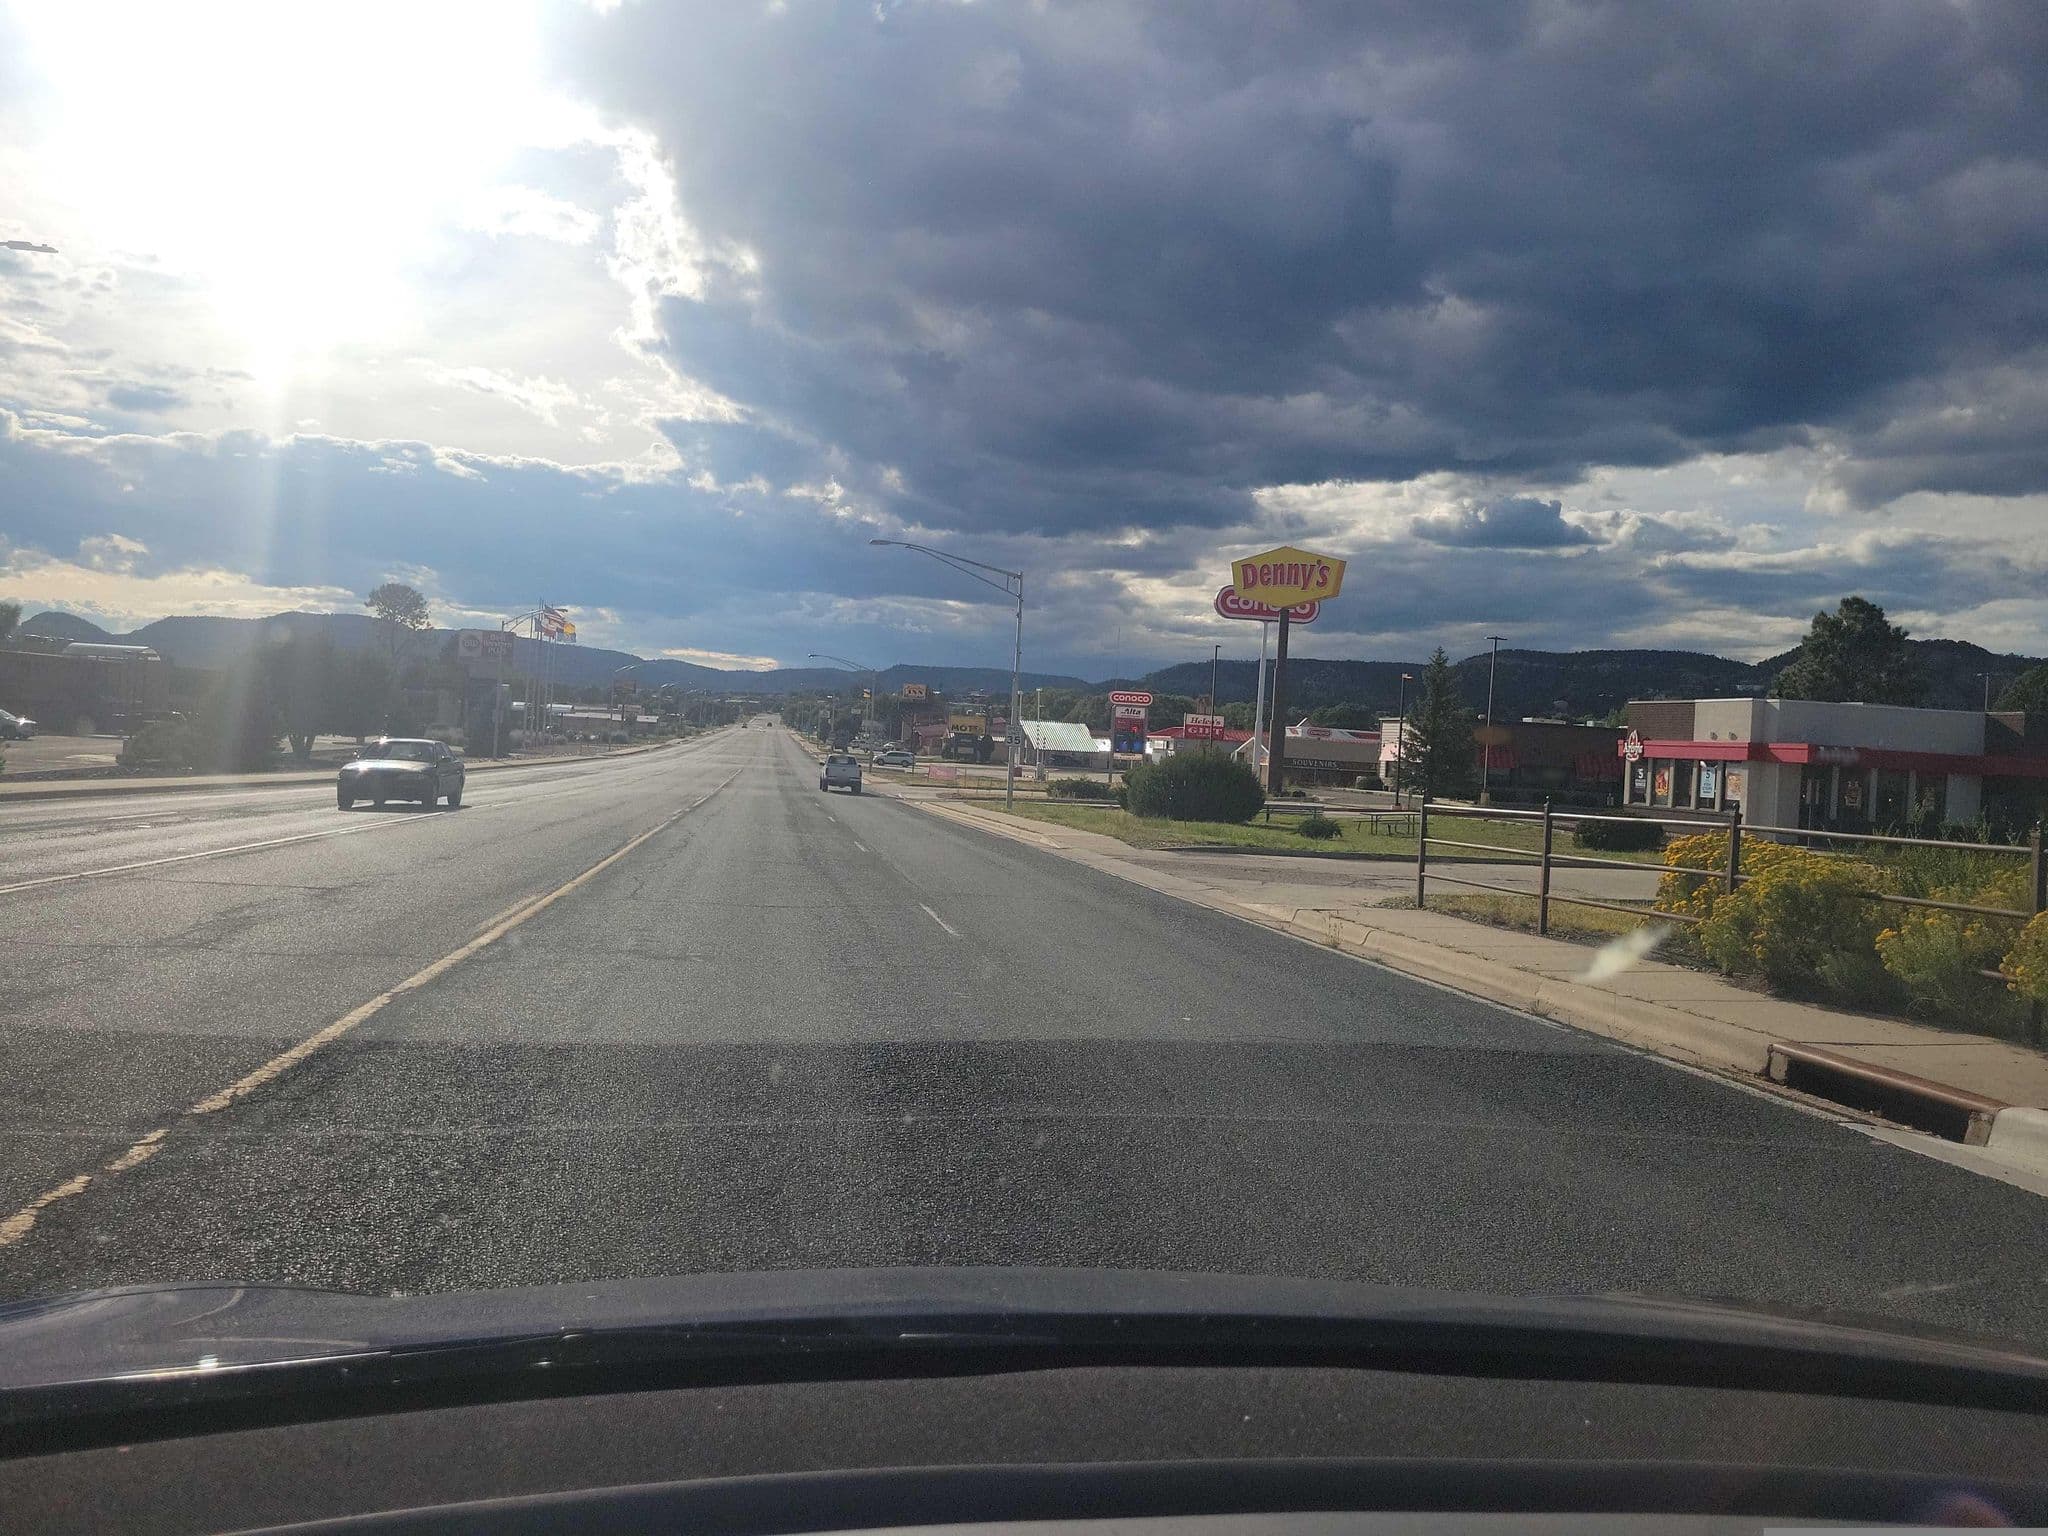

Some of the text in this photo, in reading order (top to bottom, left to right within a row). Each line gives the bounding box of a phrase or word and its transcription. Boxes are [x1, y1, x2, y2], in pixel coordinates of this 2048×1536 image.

[1241, 559, 1330, 590] Denny's
[1121, 707, 1141, 715] Alta
[1190, 717, 1221, 725] Hele's
[1006, 736, 1021, 744] 35
